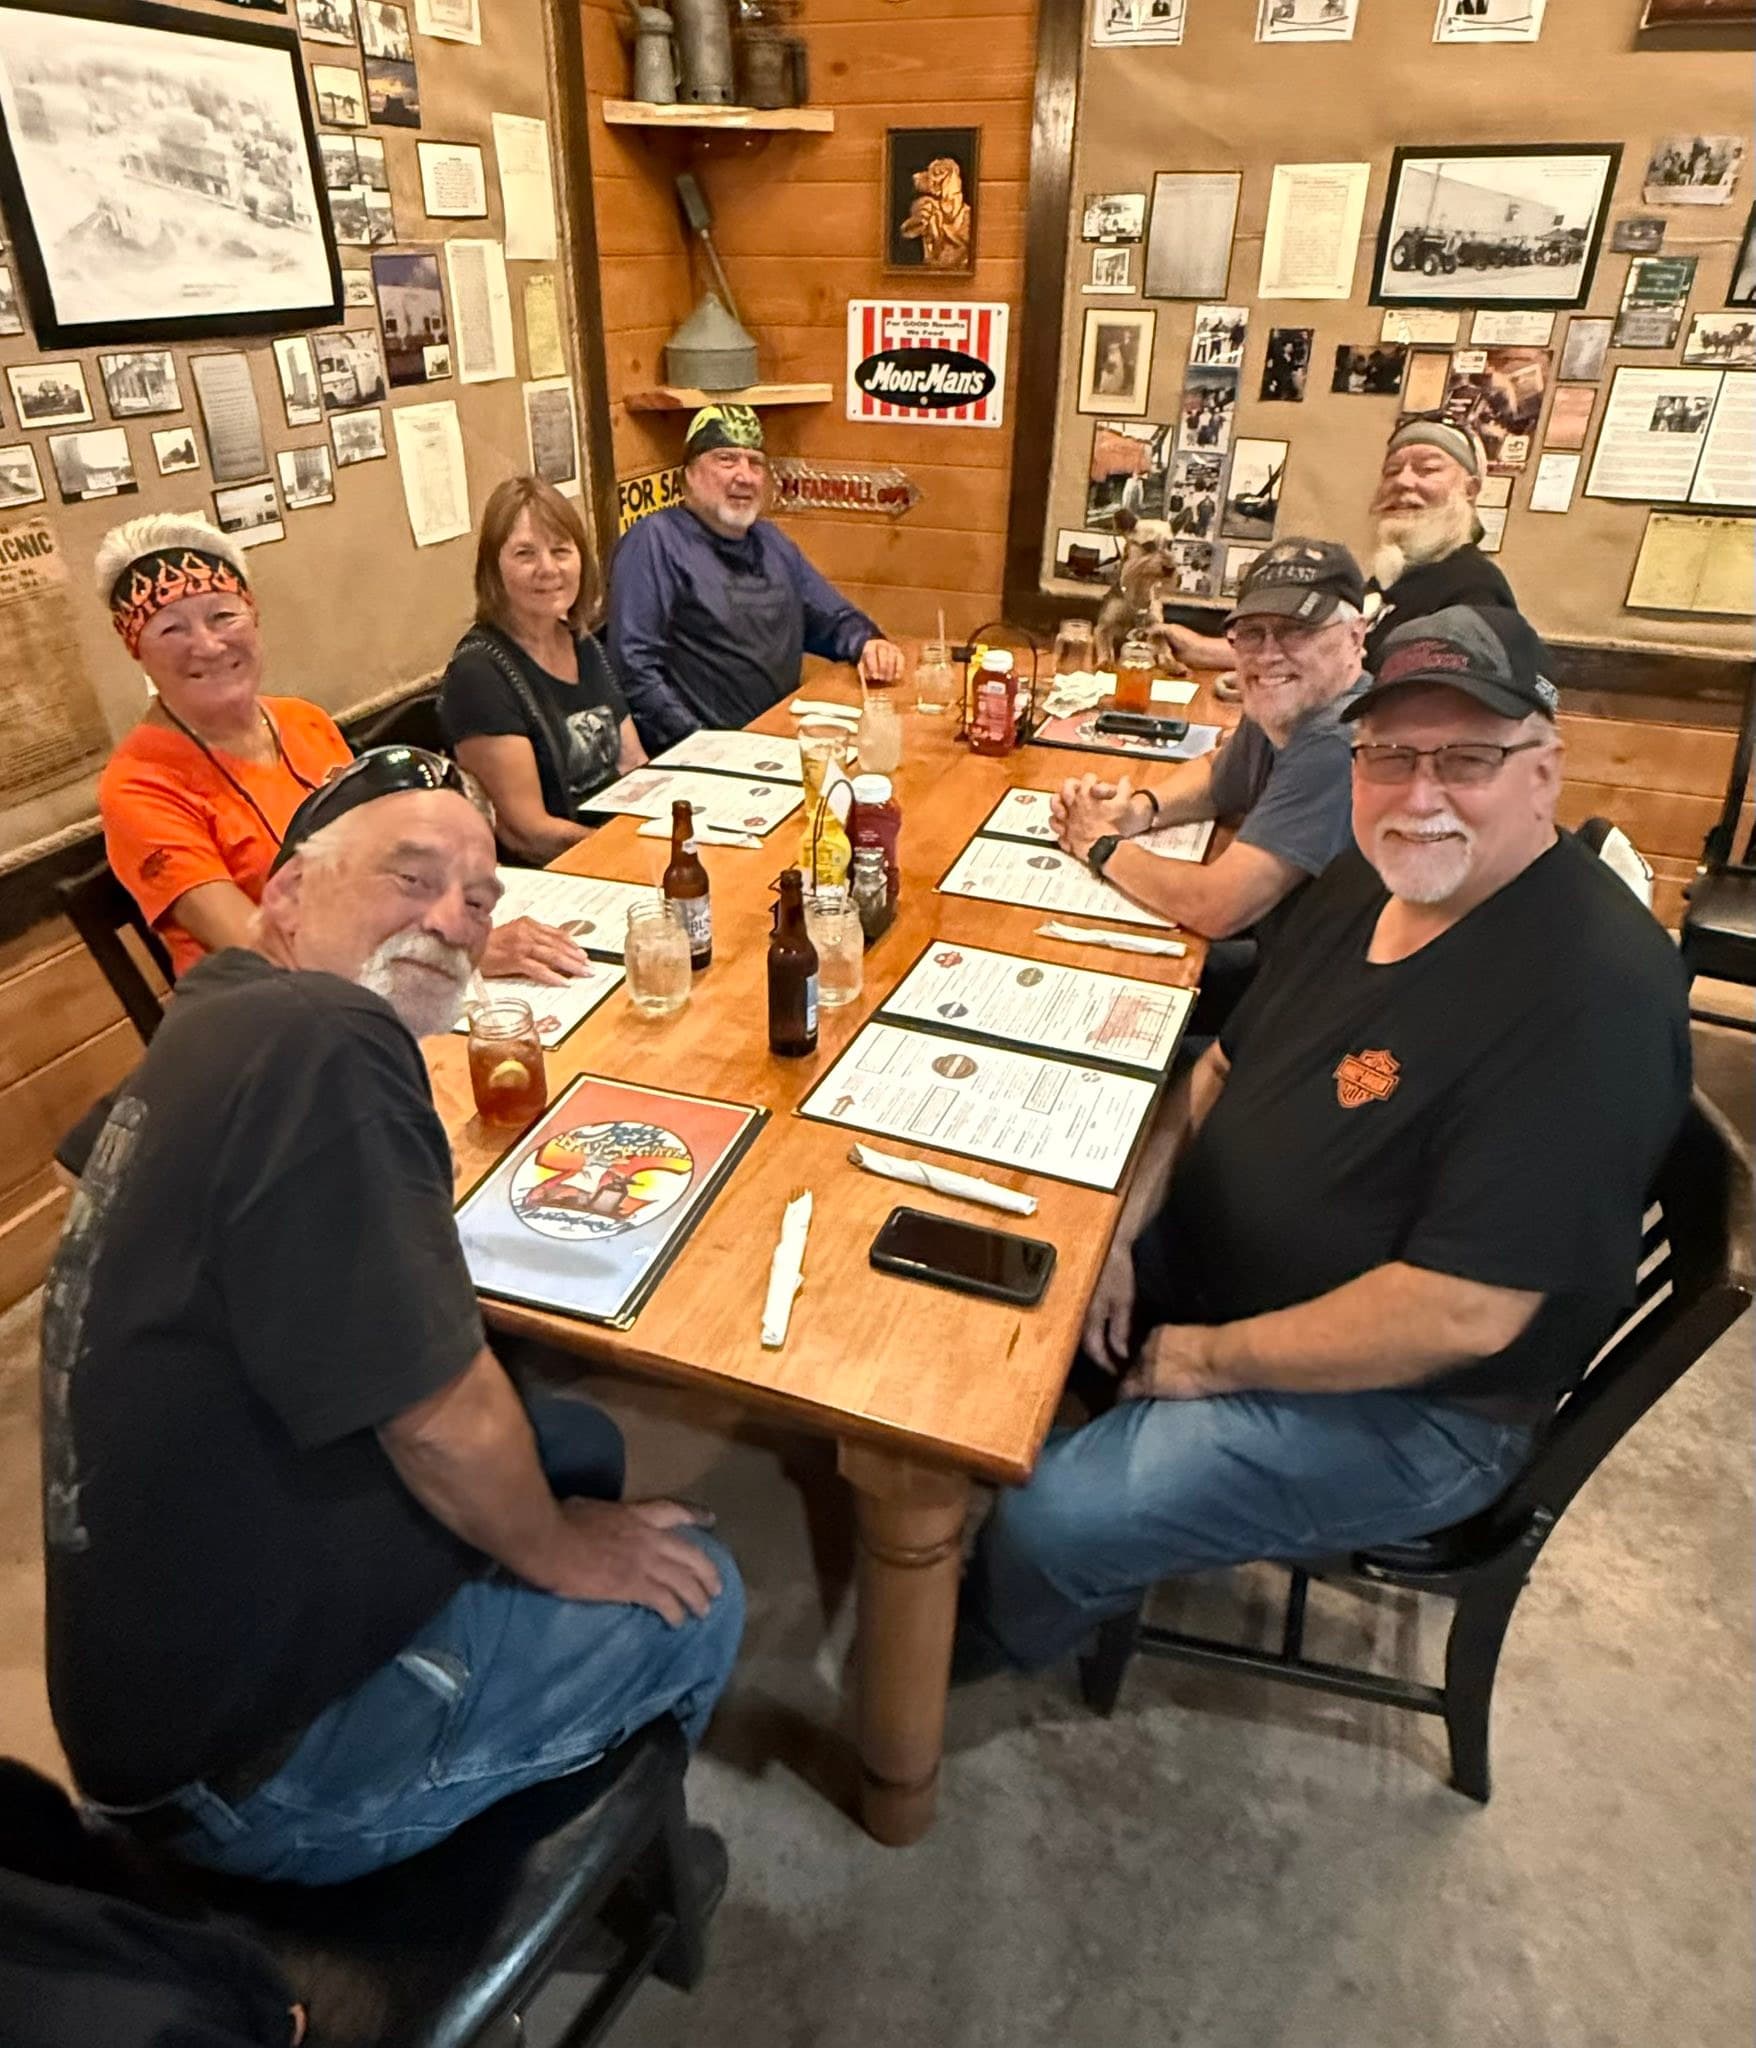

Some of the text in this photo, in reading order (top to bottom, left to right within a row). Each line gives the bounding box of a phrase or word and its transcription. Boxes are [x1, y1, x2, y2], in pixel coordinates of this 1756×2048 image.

[863, 361, 986, 395] MoorMan's
[618, 478, 656, 518] FOR
[660, 470, 684, 502] SA
[0, 531, 53, 565] ICNIC
